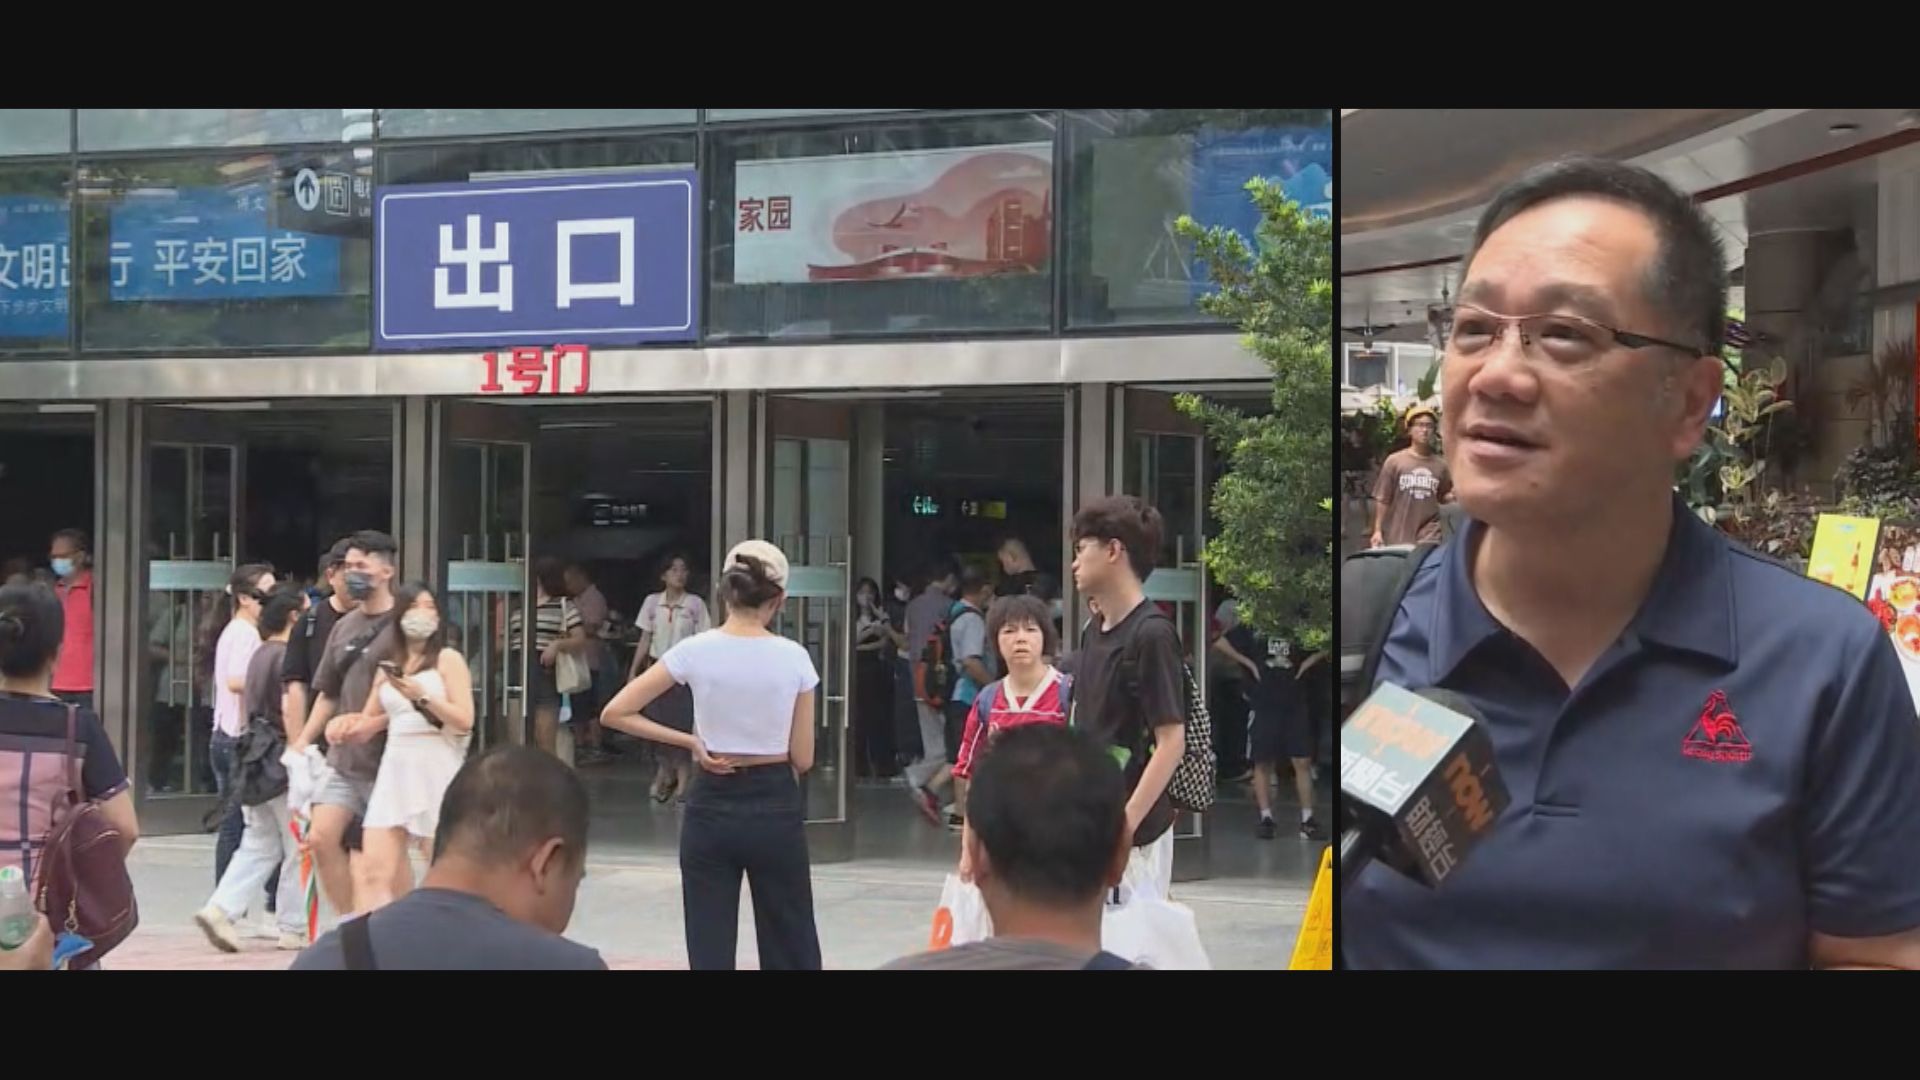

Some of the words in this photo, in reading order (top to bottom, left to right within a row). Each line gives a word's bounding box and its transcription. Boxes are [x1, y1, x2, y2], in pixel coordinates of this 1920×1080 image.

[739, 196, 791, 232] 家园
[154, 232, 306, 286] 平安回家
[434, 214, 634, 311] 出口
[480, 344, 591, 395] 1号门
[1443, 751, 1492, 831] now
